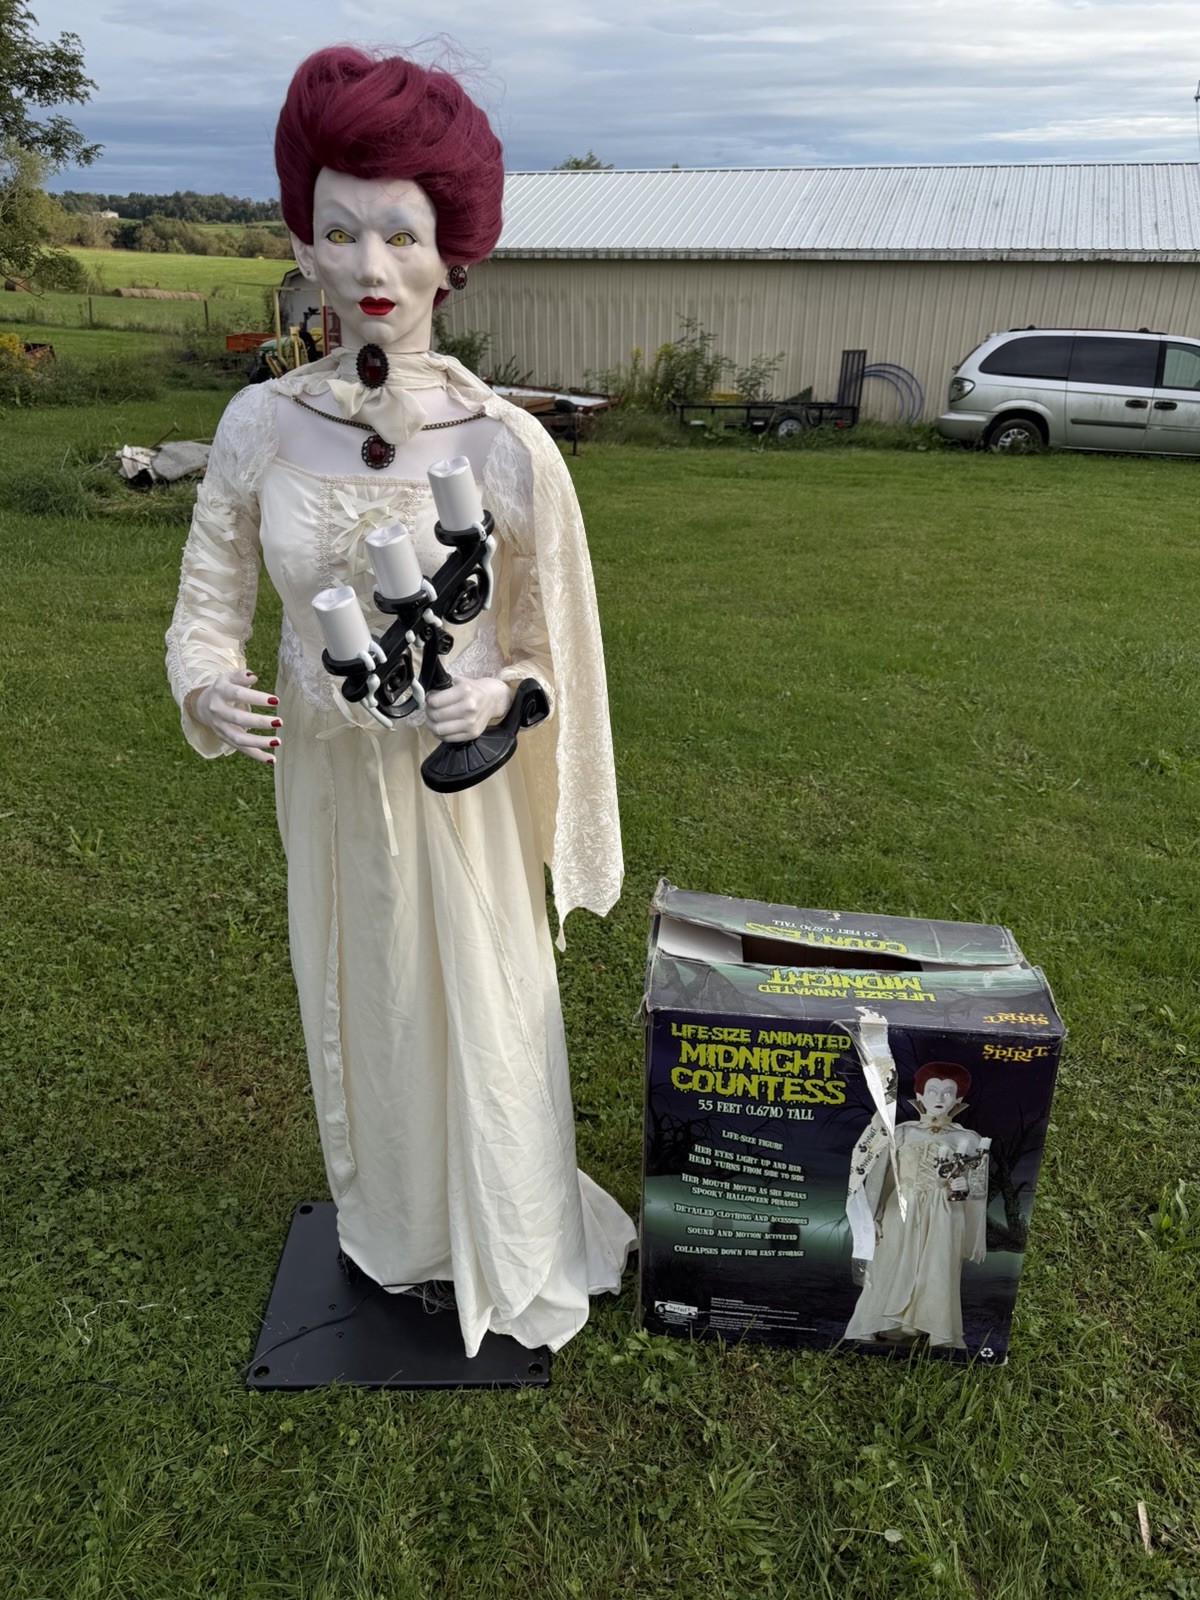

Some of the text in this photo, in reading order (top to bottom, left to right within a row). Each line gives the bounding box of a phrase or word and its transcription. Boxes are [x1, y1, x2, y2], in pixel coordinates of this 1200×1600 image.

[772, 919, 796, 928] TALL
[837, 928, 860, 936] FEET
[767, 968, 922, 991] MIDNIGHT
[758, 983, 936, 1002] LIFE-SIZE ANIMATED
[982, 1012, 1049, 1025] SPIRIT
[671, 1022, 851, 1050] LIFE-SIZE ANIMATED
[679, 1040, 841, 1078] MIDNIGHT
[982, 1044, 1049, 1062] SPIRIT
[671, 1066, 846, 1105] COUNTESS
[716, 1101, 742, 1114] FEET
[787, 1108, 815, 1120] TALL
[722, 1130, 784, 1150] LIFE-SIZE FIGURE
[688, 1153, 805, 1182] HEAD TURNS FROM SIDE TO SIDE
[694, 1144, 802, 1174] HER EYES LIGHT UP AND HER
[681, 1173, 807, 1200] HER MOUTH MOVES AS SHE SPEAKS
[691, 1186, 799, 1207] SPOOKY HALLOWEEN PHRASES
[675, 1203, 808, 1225] DETAILED CLOTHING AND ACCESSORIES
[687, 1226, 798, 1240] SOUND AND MOTION ACTIVATED
[674, 1244, 719, 1255] COLLAPSES
[721, 1248, 743, 1256] DOWN
[759, 1249, 776, 1257] EASY
